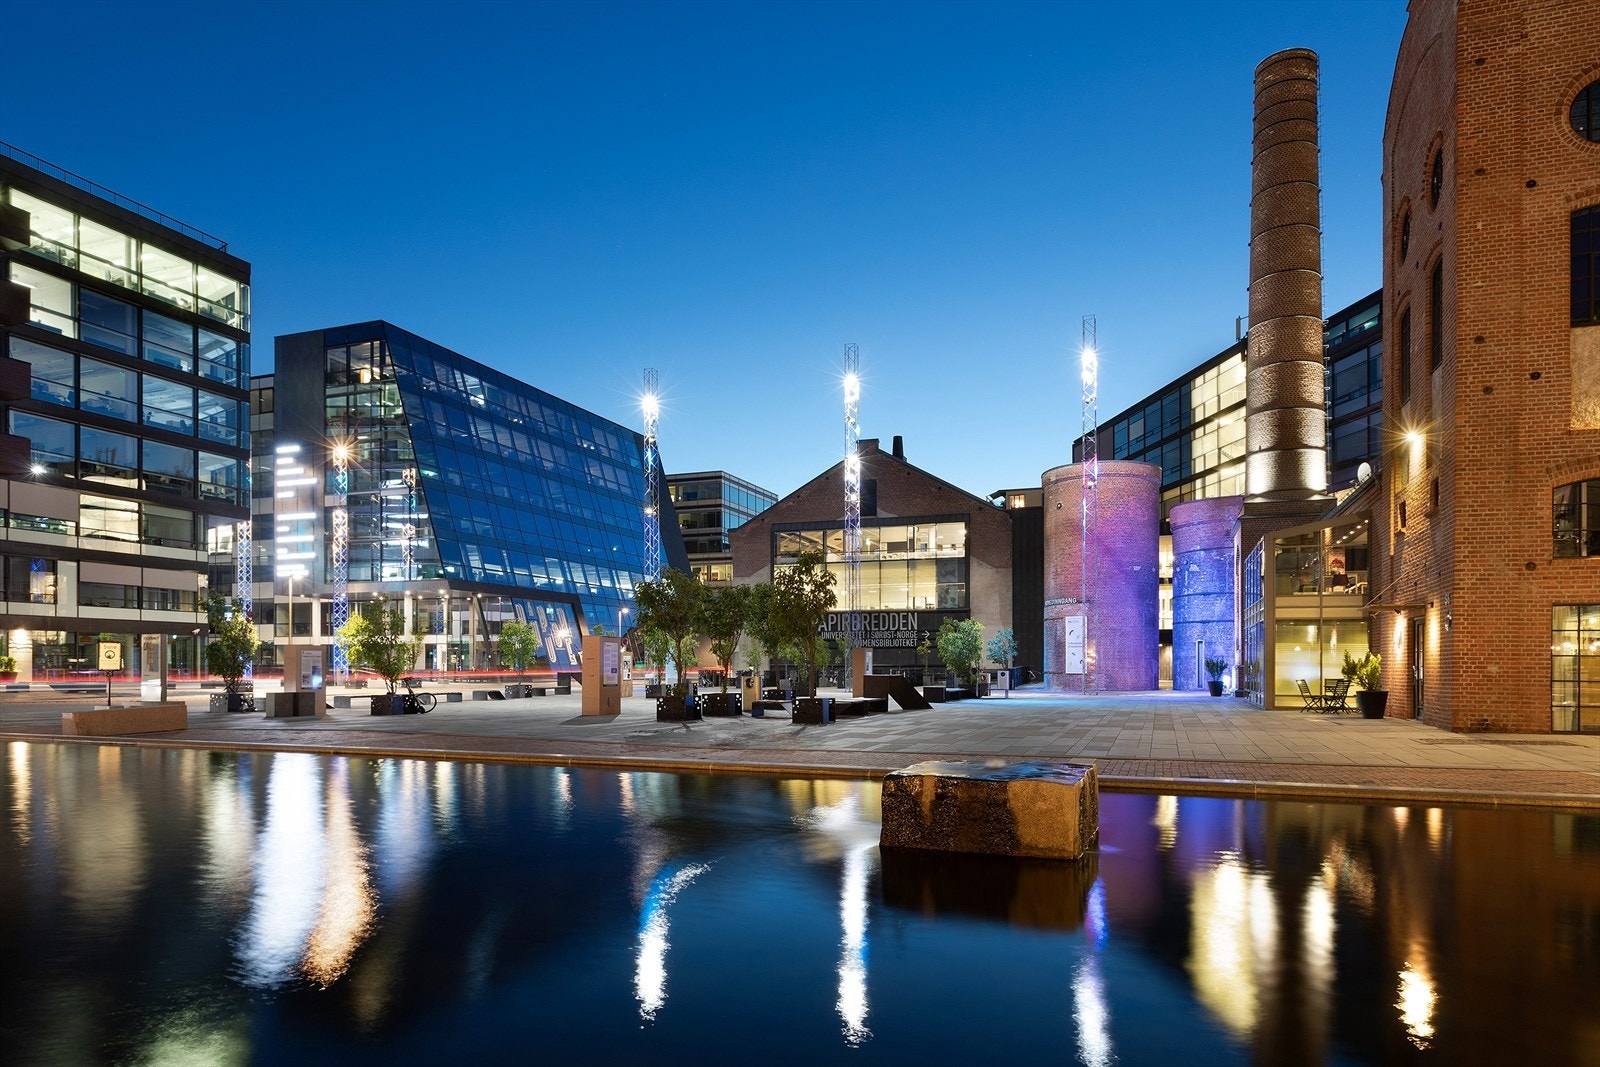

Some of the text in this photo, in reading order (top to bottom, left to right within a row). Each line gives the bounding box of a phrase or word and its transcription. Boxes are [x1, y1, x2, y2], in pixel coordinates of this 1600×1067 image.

[814, 613, 917, 631] APIRBREDDEN
[821, 631, 866, 639] UNIVERSETET
[871, 631, 917, 639] SØRØST-NORGE
